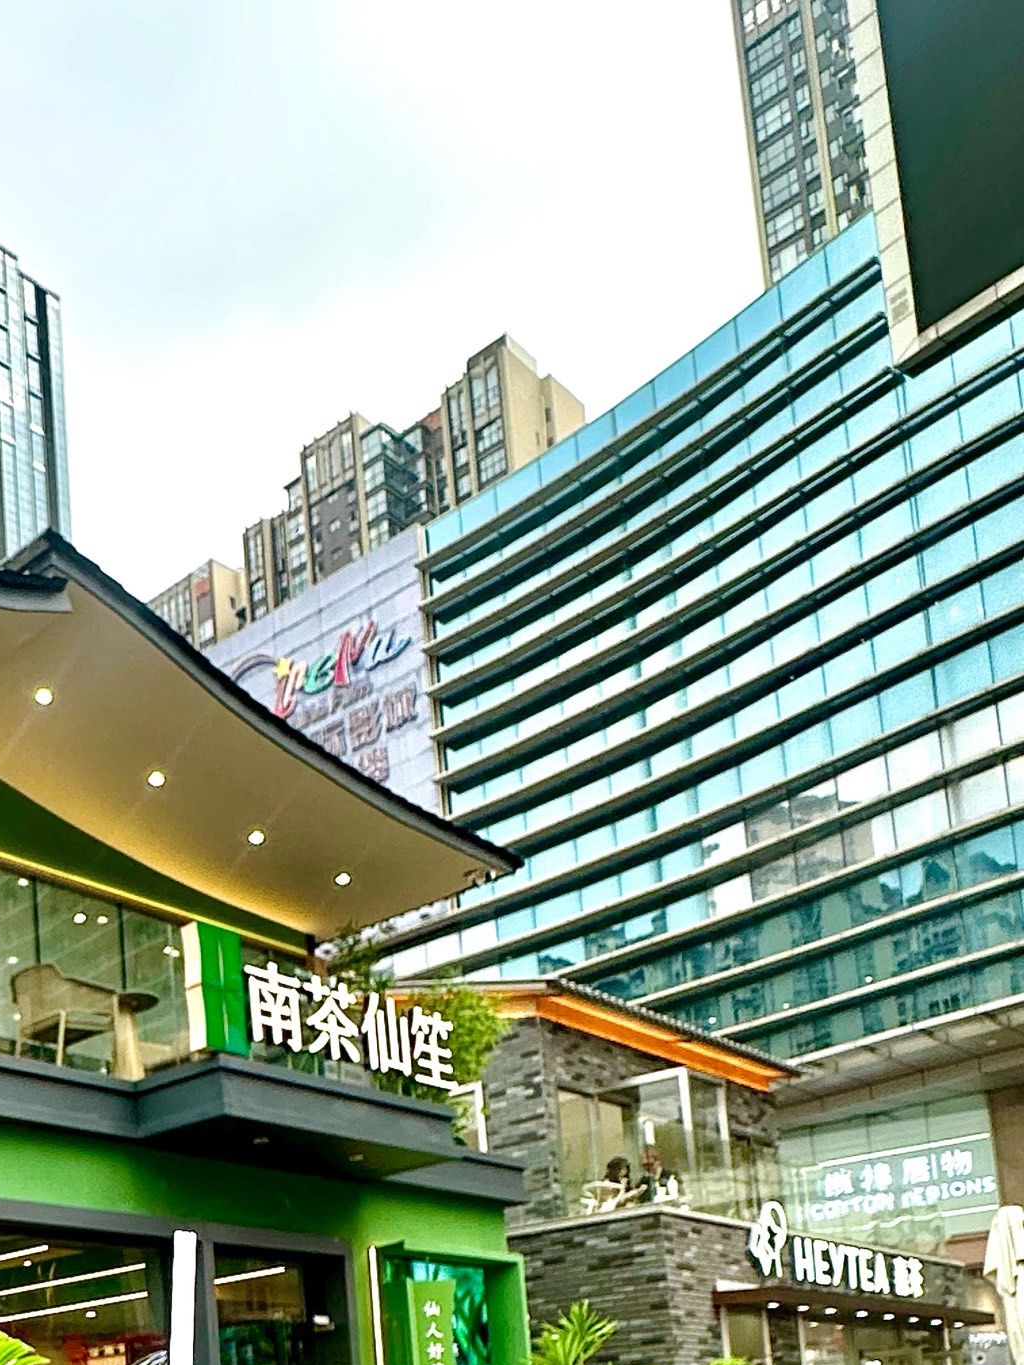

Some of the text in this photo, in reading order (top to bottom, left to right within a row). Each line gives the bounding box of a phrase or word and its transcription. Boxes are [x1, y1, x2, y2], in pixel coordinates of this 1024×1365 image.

[243, 961, 459, 1091] 南茶仙笙
[793, 1236, 890, 1295] HEYTEA
